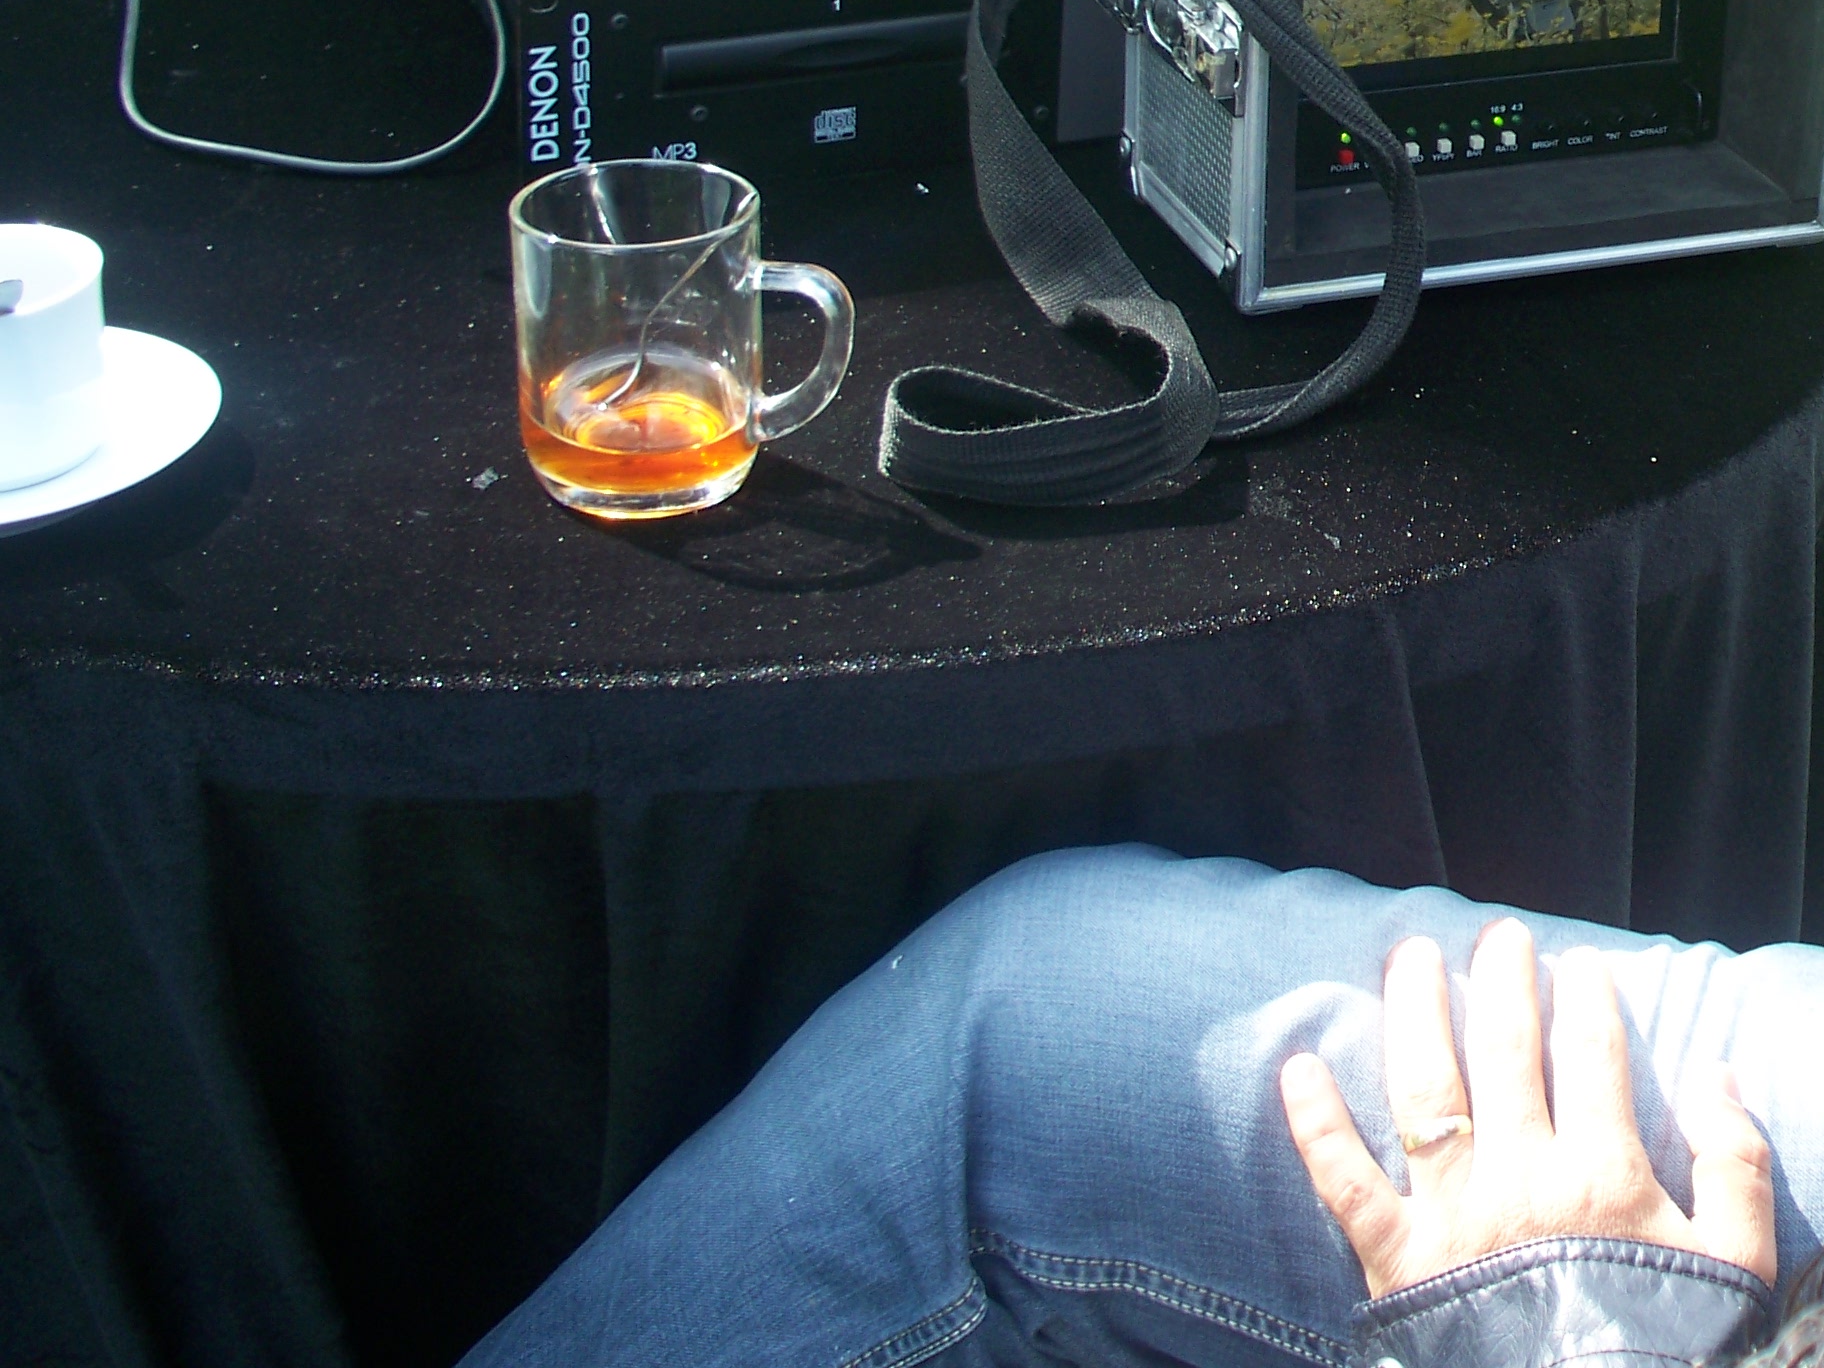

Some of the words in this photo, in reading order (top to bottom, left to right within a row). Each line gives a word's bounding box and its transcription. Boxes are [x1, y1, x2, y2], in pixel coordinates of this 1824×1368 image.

[528, 45, 560, 162] DENON
[572, 12, 592, 163] N-D4500
[1490, 104, 1506, 114] 16:9
[652, 142, 698, 161] MP3
[1330, 161, 1360, 174] POWER
[1495, 144, 1519, 153] RATIO
[1532, 139, 1559, 150] BRIGHT
[1567, 135, 1594, 146] COLOR
[1629, 126, 1668, 138] CONTRAST
